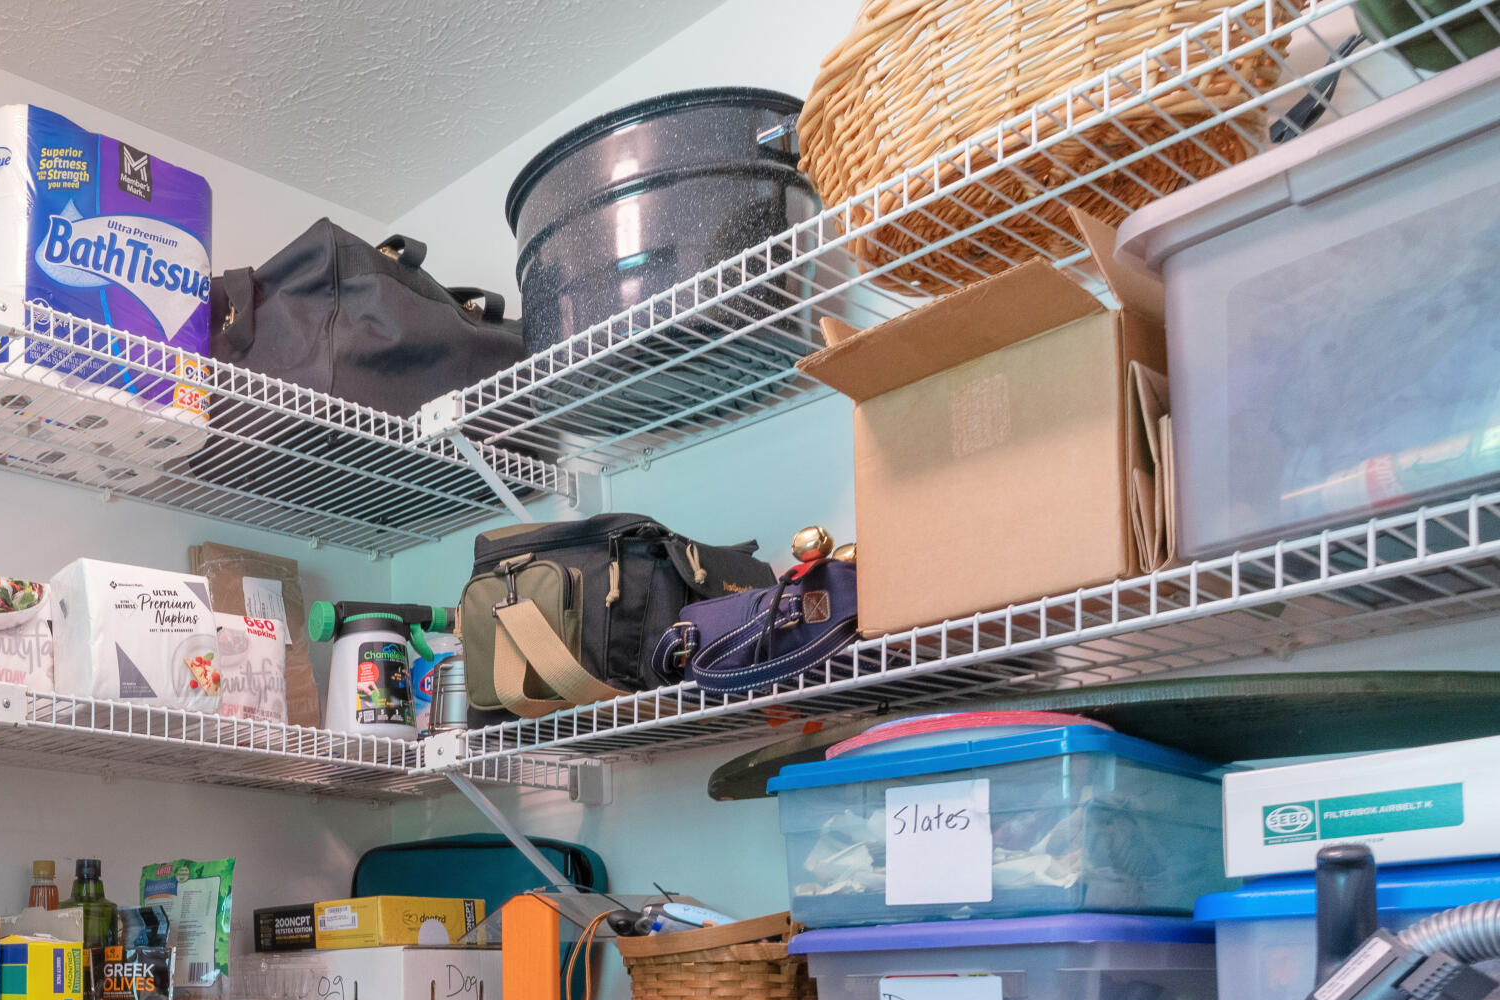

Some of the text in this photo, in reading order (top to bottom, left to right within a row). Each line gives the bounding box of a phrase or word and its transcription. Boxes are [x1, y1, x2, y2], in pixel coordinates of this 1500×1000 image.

[41, 147, 83, 159] Superior
[39, 158, 88, 171] Softness
[47, 169, 90, 182] Strength
[48, 180, 80, 190] you need
[120, 172, 151, 194] Member's
[107, 219, 178, 248] Ultra Premium
[137, 594, 197, 611] Premium
[155, 610, 199, 626] Napkins
[244, 616, 275, 632] 660
[247, 627, 277, 641] napkins
[1323, 805, 1377, 820] FILTERBOX
[1379, 801, 1423, 814] AIRBELT
[894, 803, 970, 835] Slates
[1269, 813, 1309, 826] SEBO
[104, 963, 155, 977] GREEK
[103, 978, 155, 991] OLIVES
